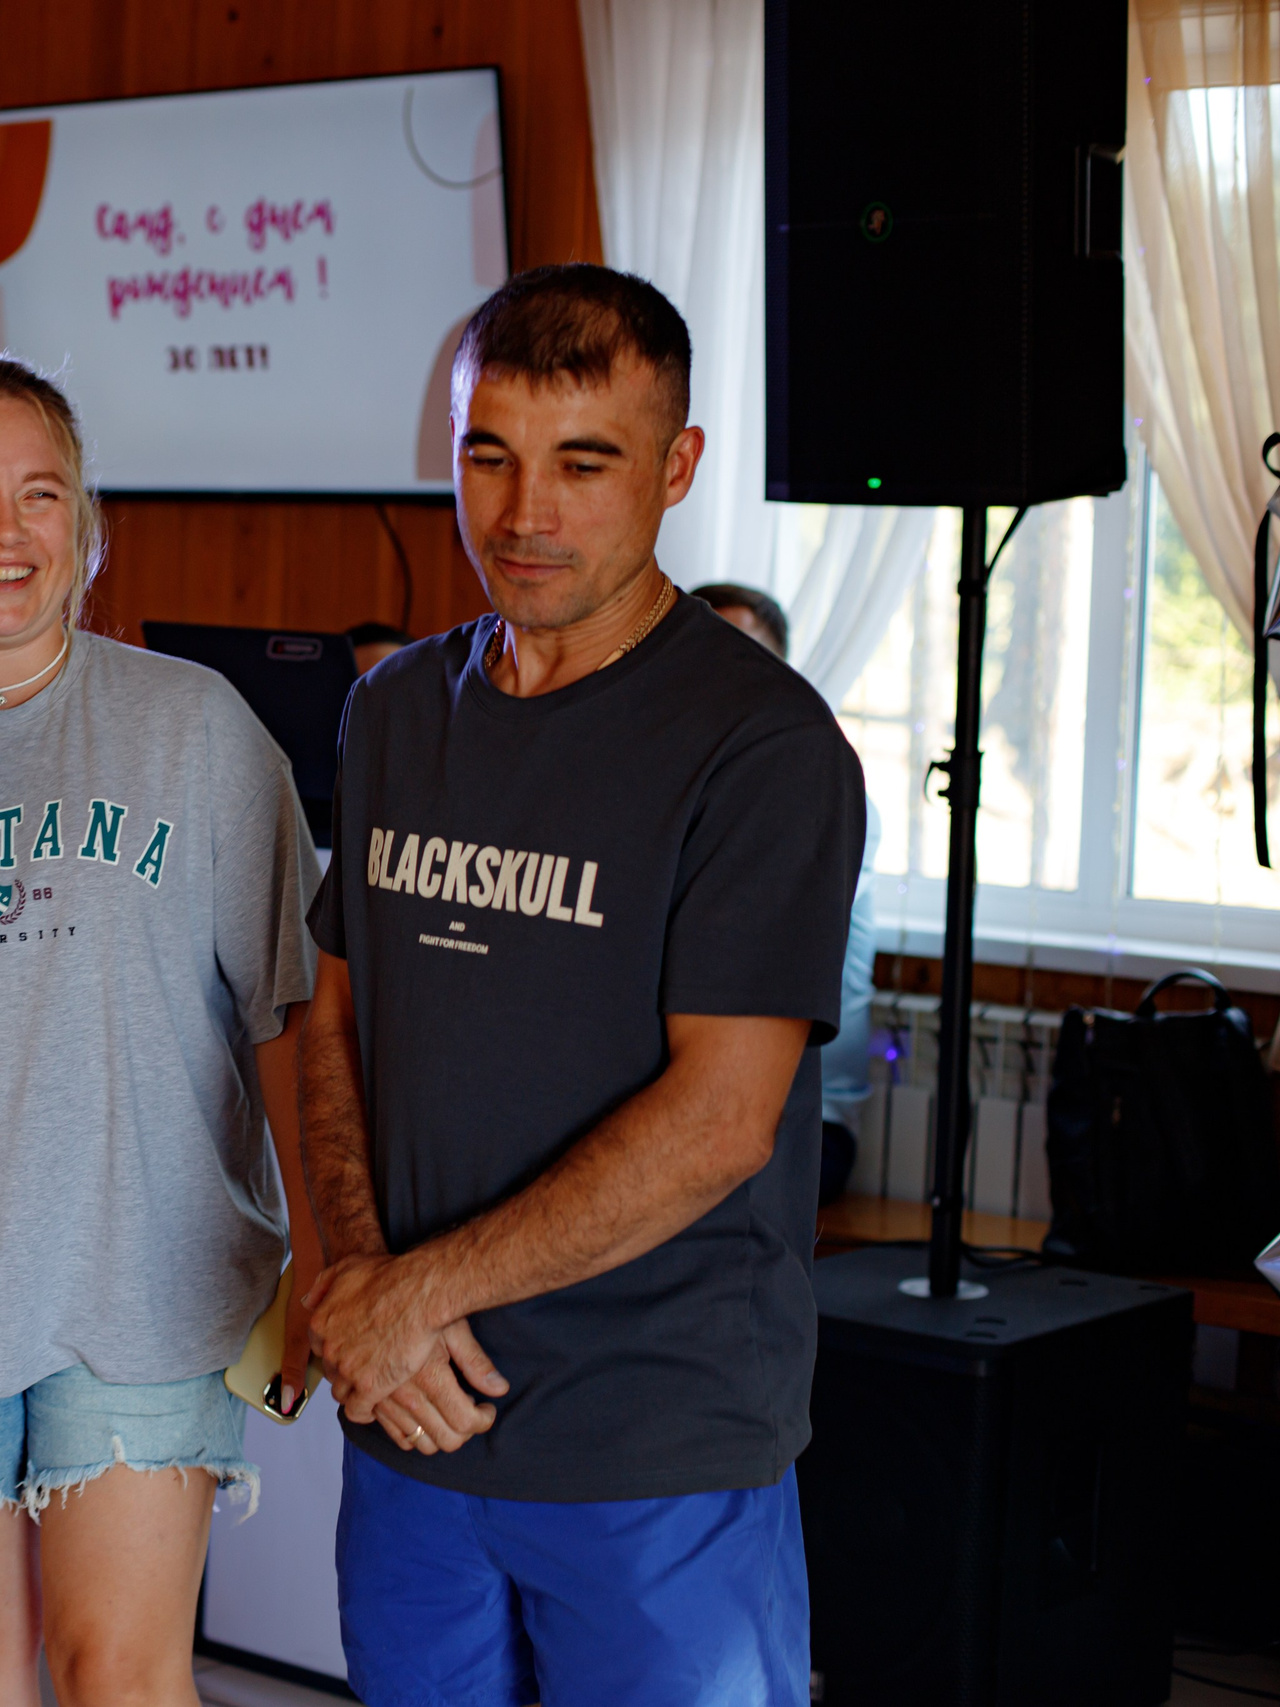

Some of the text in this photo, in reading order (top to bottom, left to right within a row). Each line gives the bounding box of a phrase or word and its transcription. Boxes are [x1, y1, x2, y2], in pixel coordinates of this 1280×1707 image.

[368, 827, 604, 928] BLACKSKULL
[448, 920, 466, 933] AND
[419, 934, 489, 955] FIGHT FOR FREEDOM
